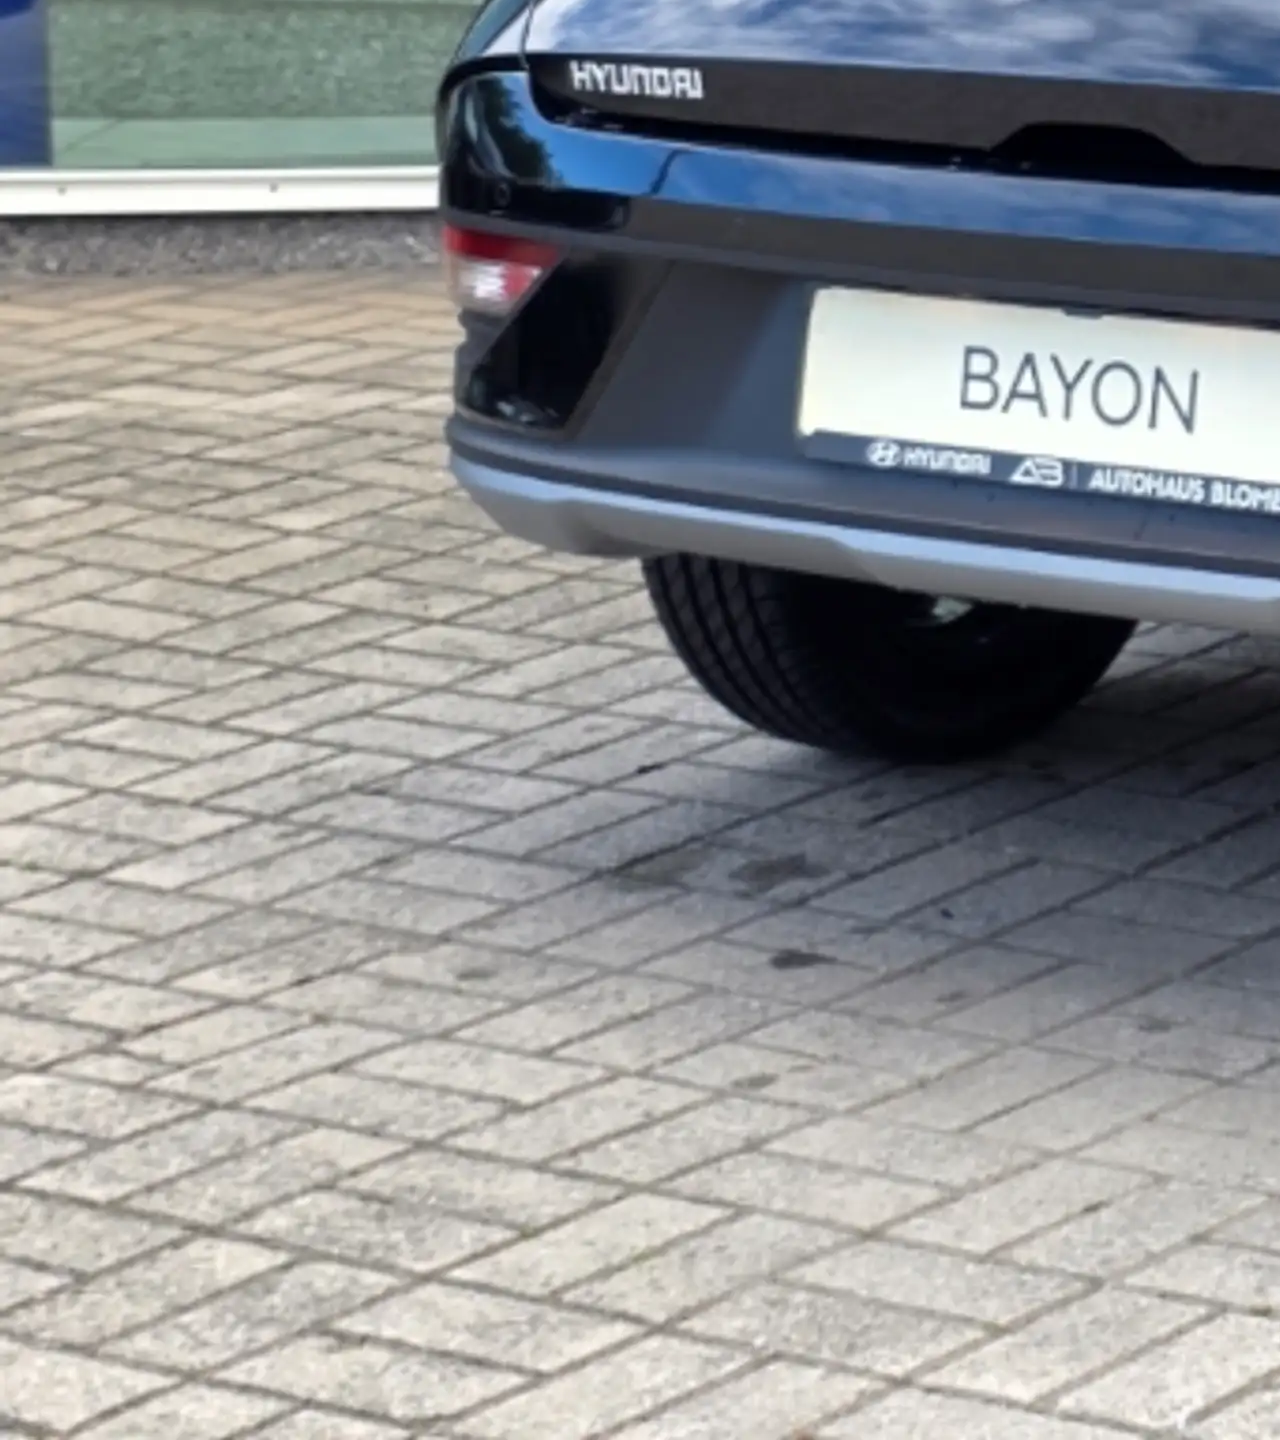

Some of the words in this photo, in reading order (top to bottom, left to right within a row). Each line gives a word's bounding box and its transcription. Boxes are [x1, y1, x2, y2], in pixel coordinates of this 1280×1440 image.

[569, 59, 704, 100] HYUNDAI
[958, 344, 1201, 435] BAYON
[902, 446, 993, 476] HYUNDAI
[1087, 466, 1207, 503] AUTOHAUS
